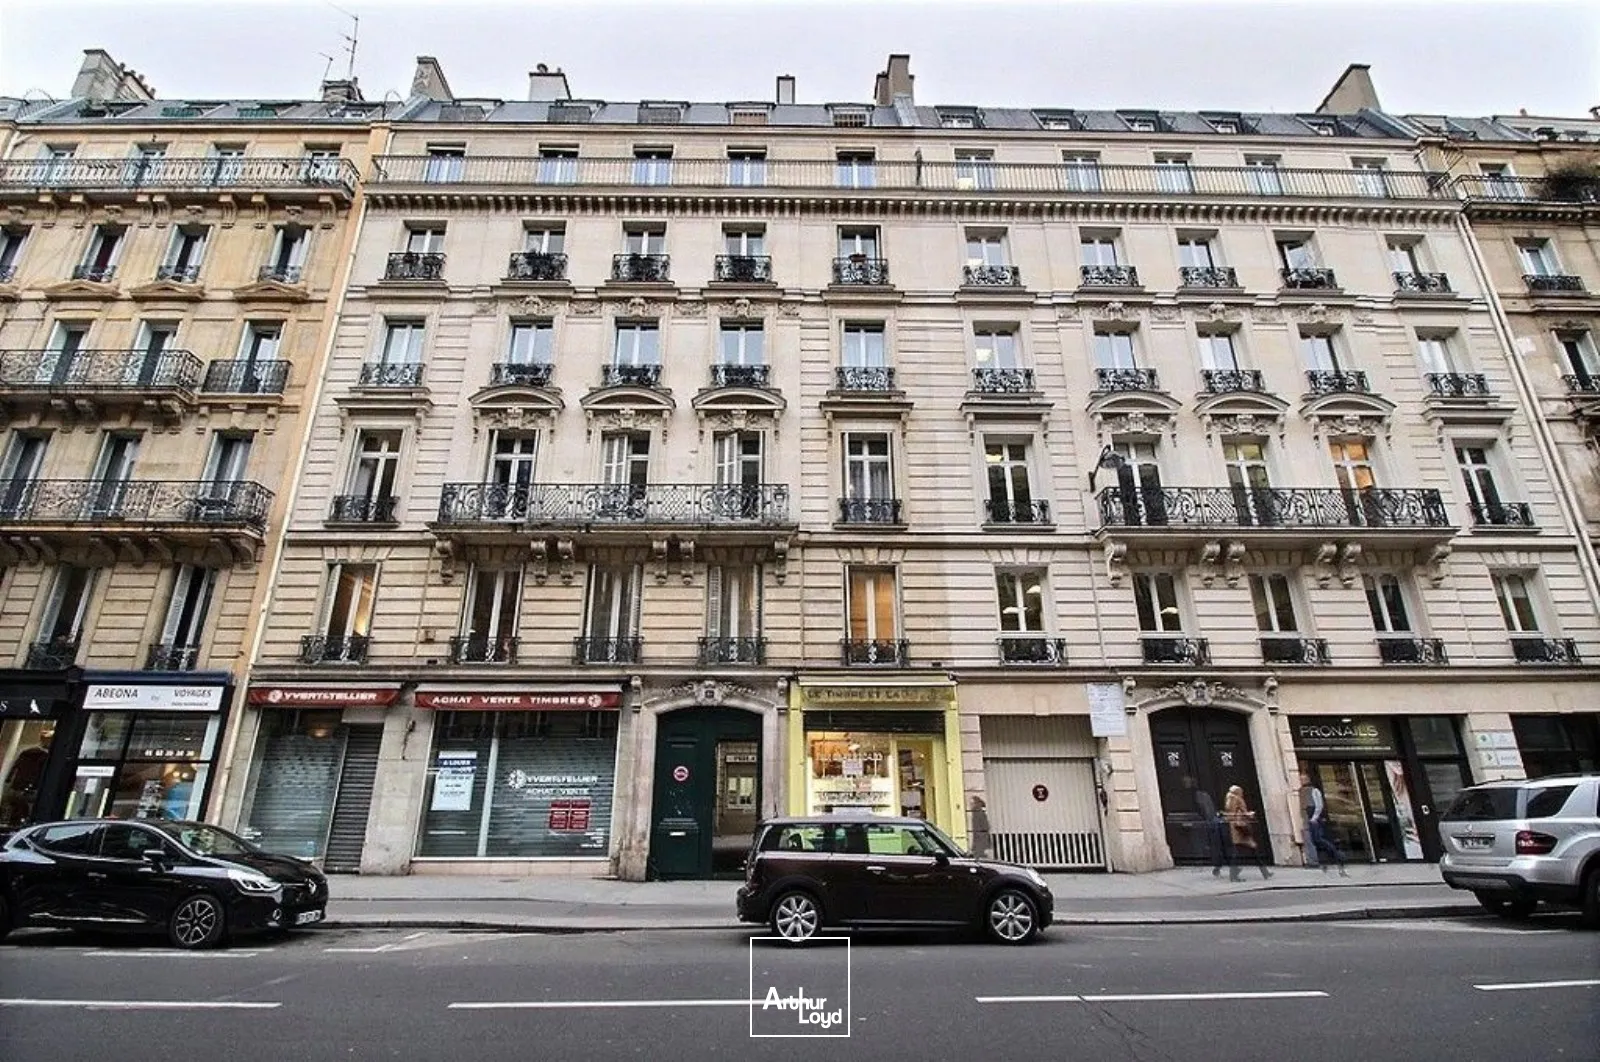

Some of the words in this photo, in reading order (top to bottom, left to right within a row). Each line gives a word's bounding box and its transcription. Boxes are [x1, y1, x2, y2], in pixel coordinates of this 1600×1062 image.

[94, 688, 139, 699] ABEONA
[174, 689, 212, 698] VOYAGES
[432, 695, 473, 704] ACHAT
[480, 695, 521, 704] VENTE
[529, 695, 586, 704] TIMBRES
[1300, 725, 1379, 737] PRONAILS
